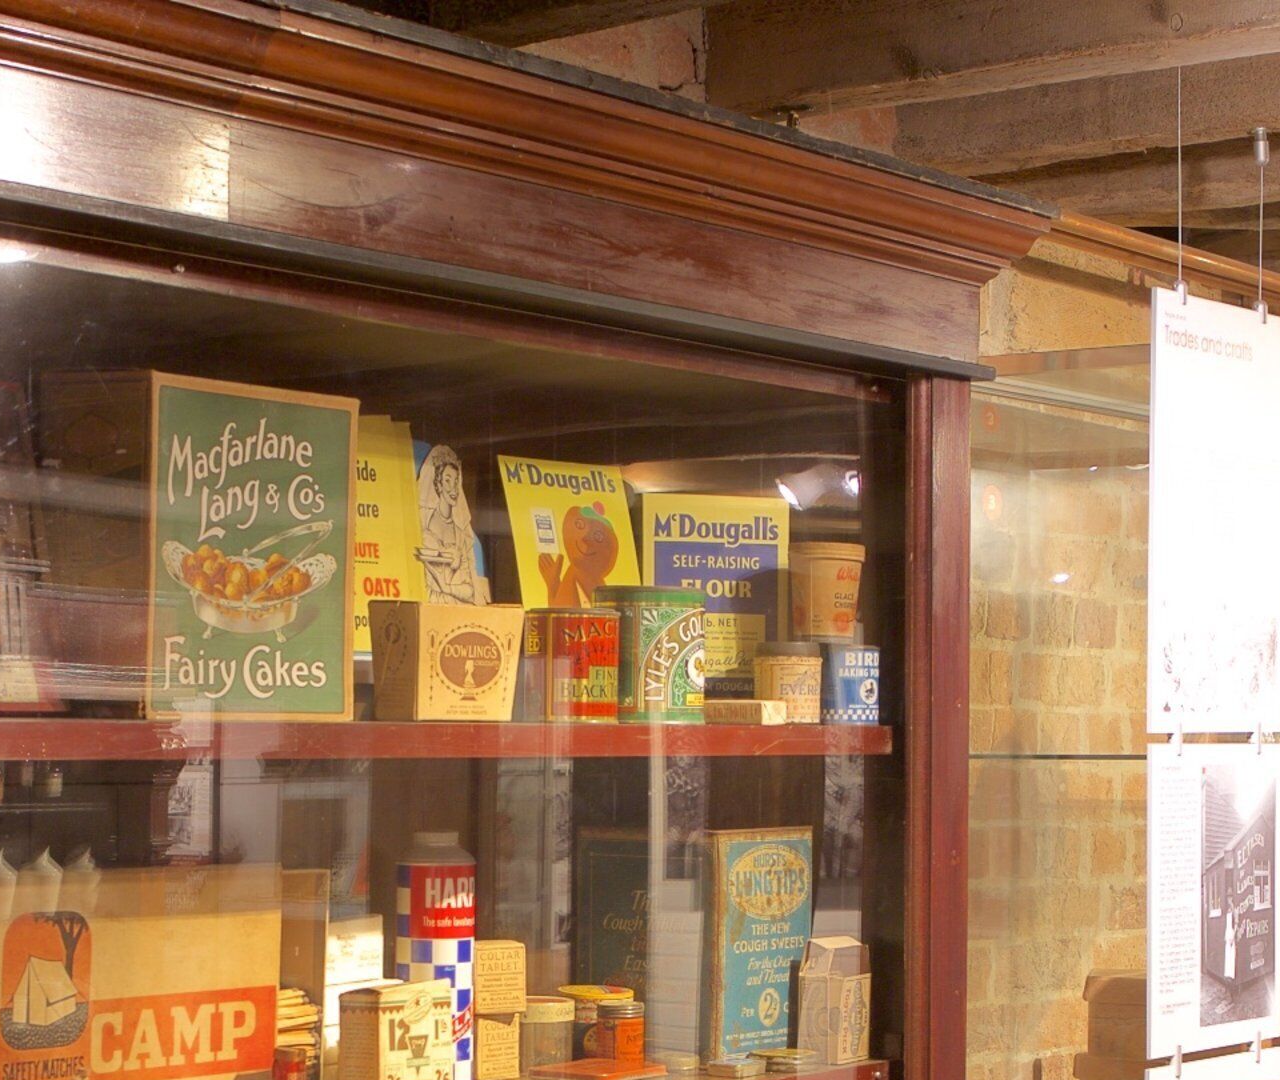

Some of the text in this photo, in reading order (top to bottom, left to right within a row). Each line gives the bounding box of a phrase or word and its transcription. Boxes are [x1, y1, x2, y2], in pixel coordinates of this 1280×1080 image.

[1165, 325, 1199, 350] Trades
[1201, 336, 1222, 356] and
[167, 417, 312, 505] Macfarlane
[504, 460, 616, 495] McDougall's
[197, 476, 260, 542] Lang
[265, 483, 280, 514] &
[654, 513, 779, 546] McDougall's
[673, 555, 759, 570] SELF-RAISING
[363, 578, 400, 597] OATS
[718, 618, 737, 627] NET
[445, 643, 498, 659] DOWLING'S
[163, 635, 327, 699] Fairy Cakes
[646, 637, 680, 701] LYLE'S
[561, 682, 607, 698] BLACK
[753, 854, 786, 868] HURST'S
[735, 869, 806, 896] LUNG TIPS
[423, 916, 451, 927] The safe
[751, 922, 791, 935] THE NEW
[734, 937, 805, 954] COUGH SWEETS
[480, 951, 520, 961] COLTAR
[748, 957, 760, 970] For
[747, 972, 762, 986] and
[90, 1000, 256, 1077] CAMP
[41, 1056, 85, 1080] MATCHES
